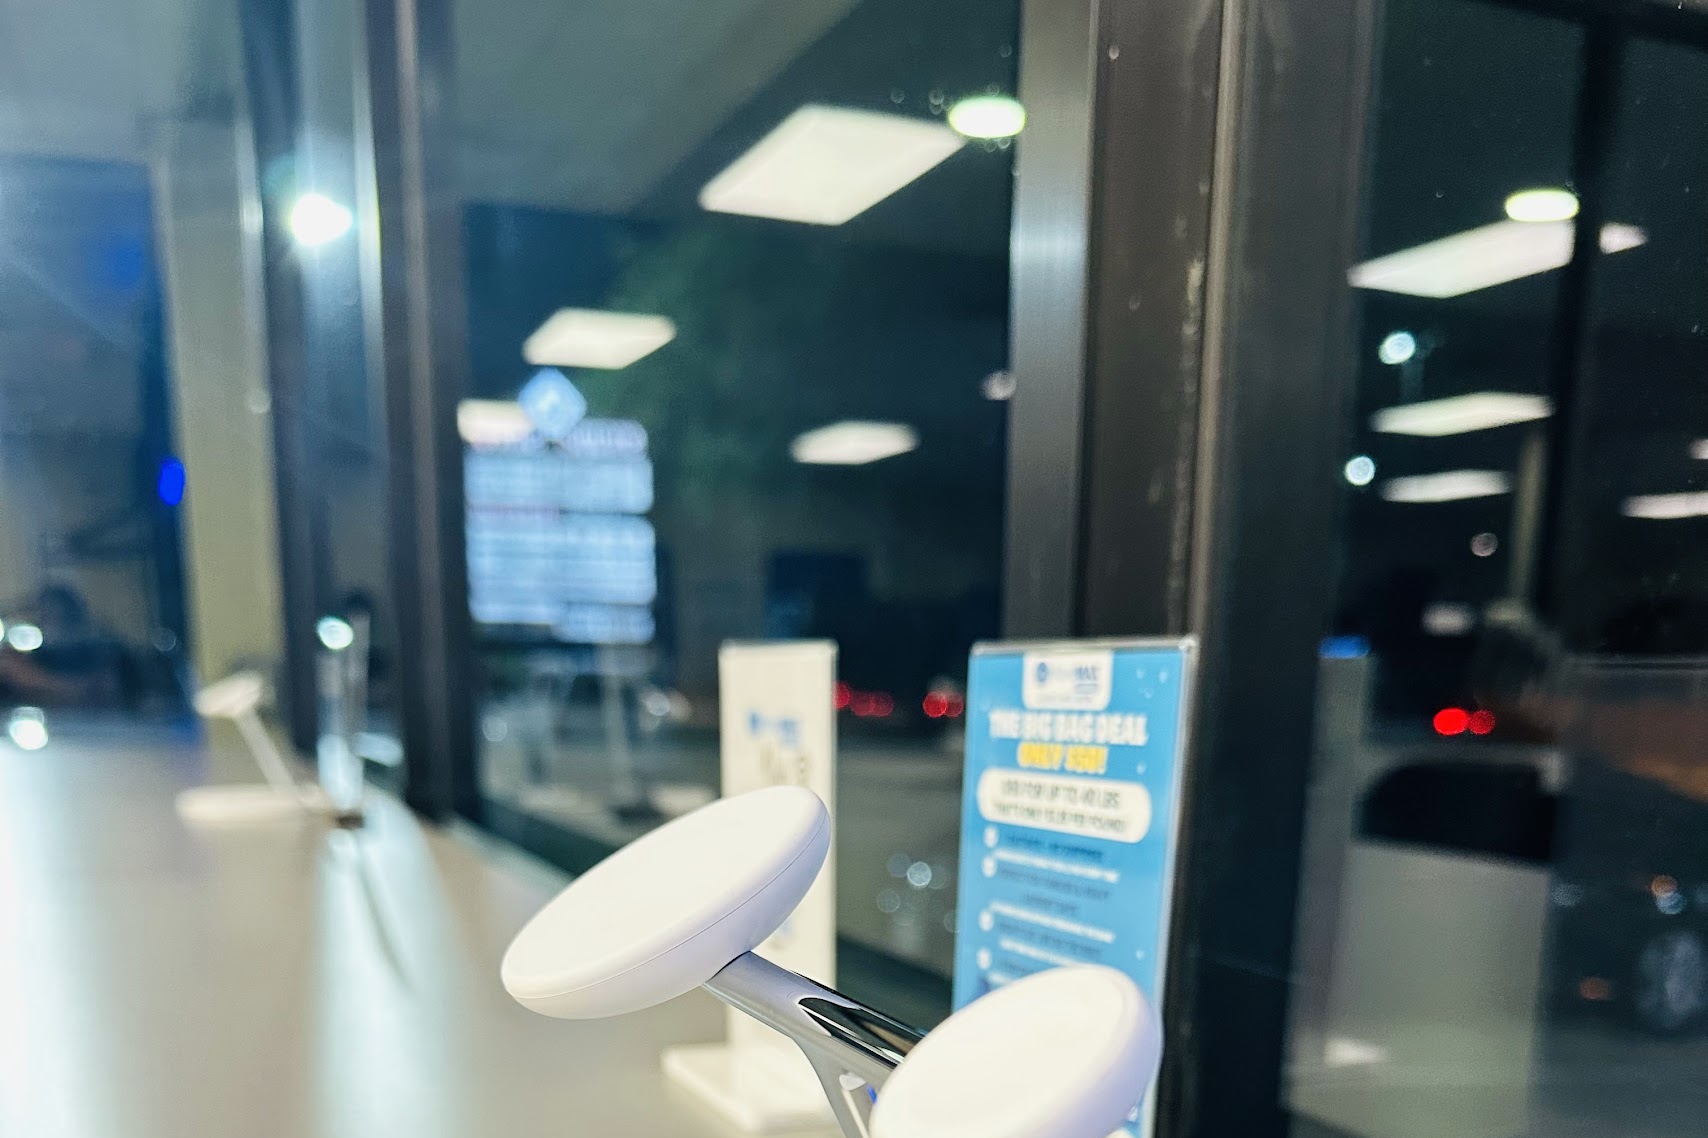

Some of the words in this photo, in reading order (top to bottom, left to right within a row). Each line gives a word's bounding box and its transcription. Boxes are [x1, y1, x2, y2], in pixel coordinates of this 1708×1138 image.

[989, 709, 1019, 738] THE
[1022, 712, 1052, 742] BIG
[1095, 715, 1148, 746] DEAL
[1018, 742, 1062, 769] ONLY
